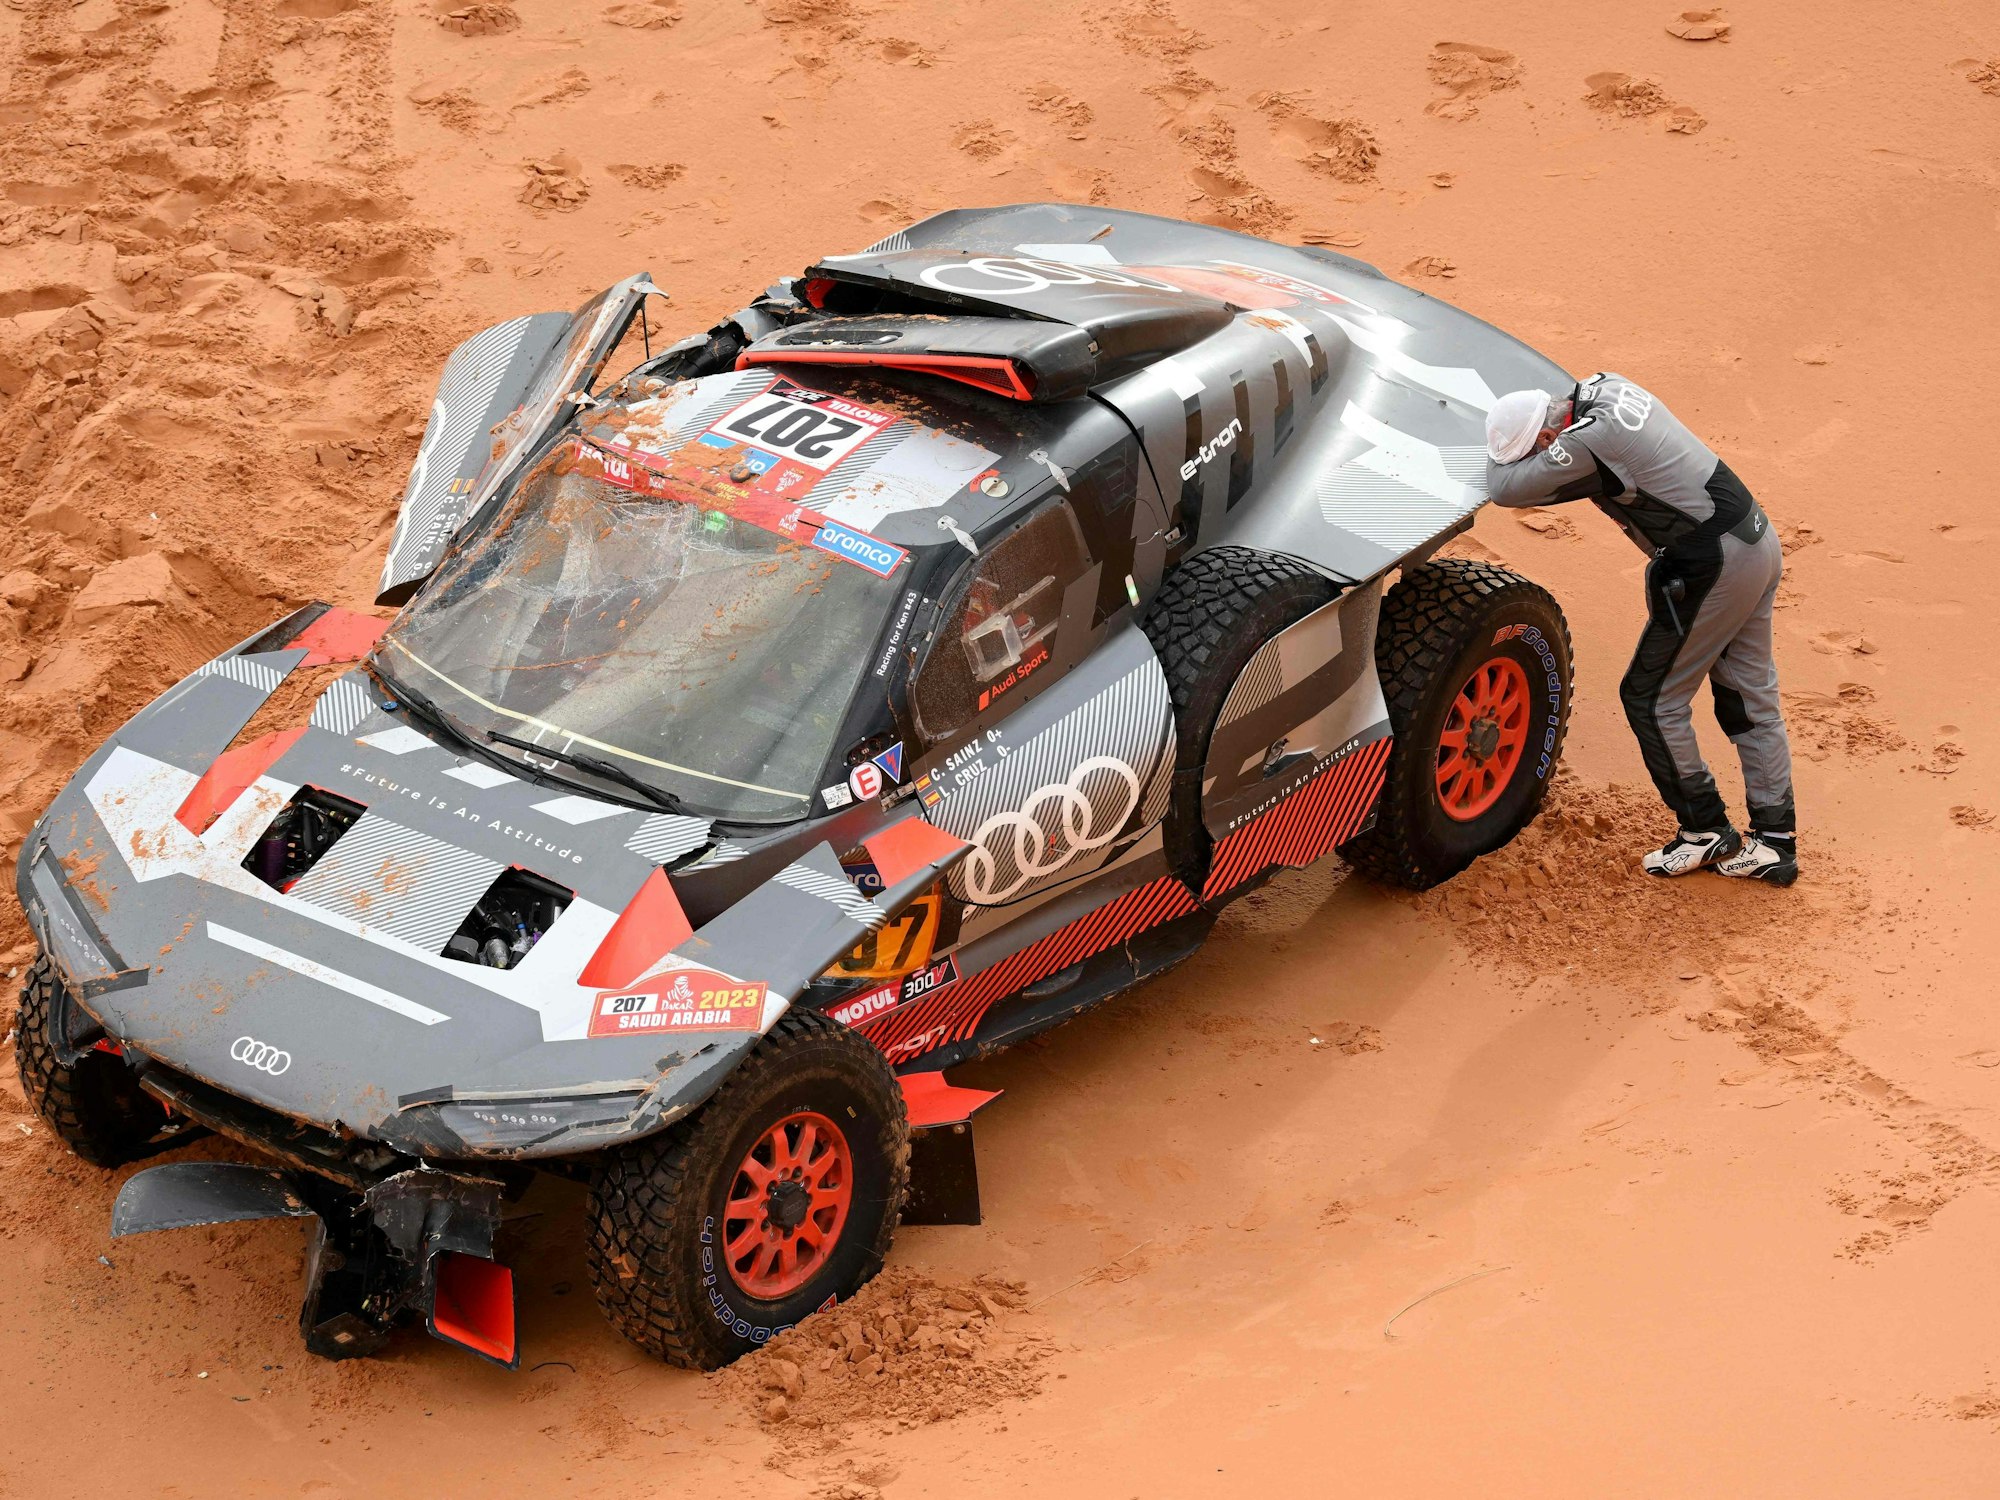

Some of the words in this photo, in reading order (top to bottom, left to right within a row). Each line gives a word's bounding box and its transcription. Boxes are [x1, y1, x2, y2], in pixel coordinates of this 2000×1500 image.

[727, 400, 863, 459] 207
[827, 400, 887, 424] MOTUL
[1180, 418, 1242, 481] e-tron
[421, 513, 445, 553] SAINZ
[822, 529, 892, 565] aramco
[877, 646, 896, 676] Racing
[890, 631, 900, 645] for
[896, 612, 909, 629] Ken
[904, 592, 917, 610] #43
[991, 672, 1016, 699] Audi
[1017, 650, 1048, 679] Sport
[931, 768, 945, 781] C.
[946, 739, 983, 771] SAINZ
[939, 786, 956, 797] L.
[955, 759, 987, 786] CRUZ
[855, 767, 877, 796] E
[1229, 796, 1277, 829] #Future
[1281, 786, 1291, 797] Is
[1295, 774, 1309, 787] An
[1312, 738, 1359, 775] Attitude
[340, 764, 421, 800] #Future
[428, 796, 447, 809] Is
[453, 807, 480, 822] An
[488, 820, 583, 864] Attitude
[1727, 858, 1759, 871] ASTARS
[613, 996, 646, 1013] 207
[699, 988, 759, 1010] 2023
[834, 988, 896, 1025] MOTUL
[905, 961, 949, 998] 300V
[618, 1013, 667, 1029] SAUDI
[670, 1010, 731, 1026] ARABIA
